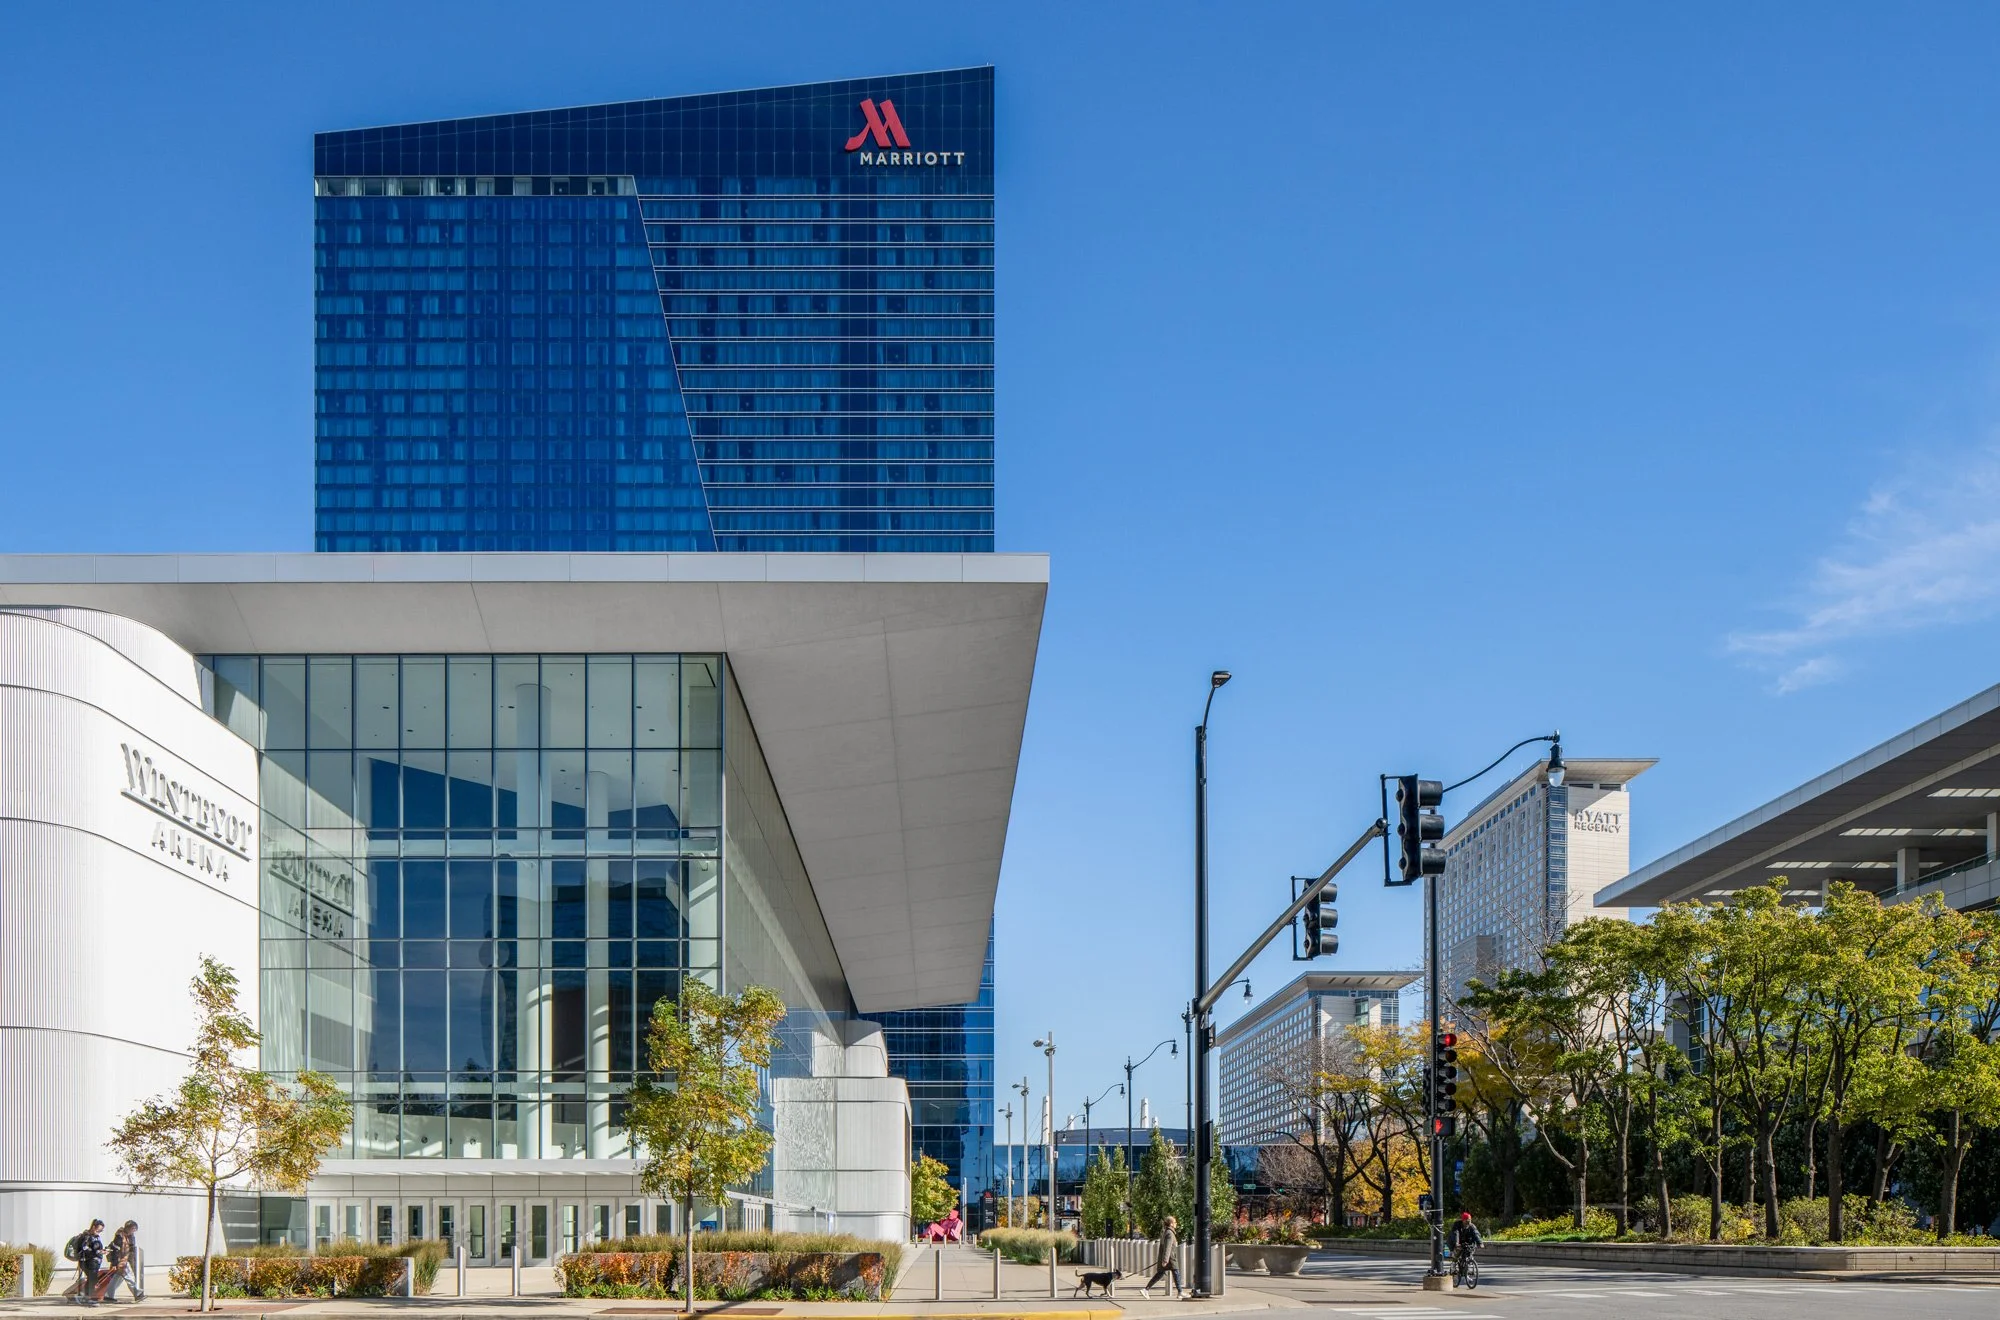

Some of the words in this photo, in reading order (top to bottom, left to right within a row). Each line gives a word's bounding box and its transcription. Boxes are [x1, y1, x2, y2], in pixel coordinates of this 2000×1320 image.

[859, 152, 965, 166] MARRIOTT
[1574, 809, 1622, 825] HYATT
[1574, 821, 1621, 834] REGENCY
[151, 821, 229, 882] ARENA
